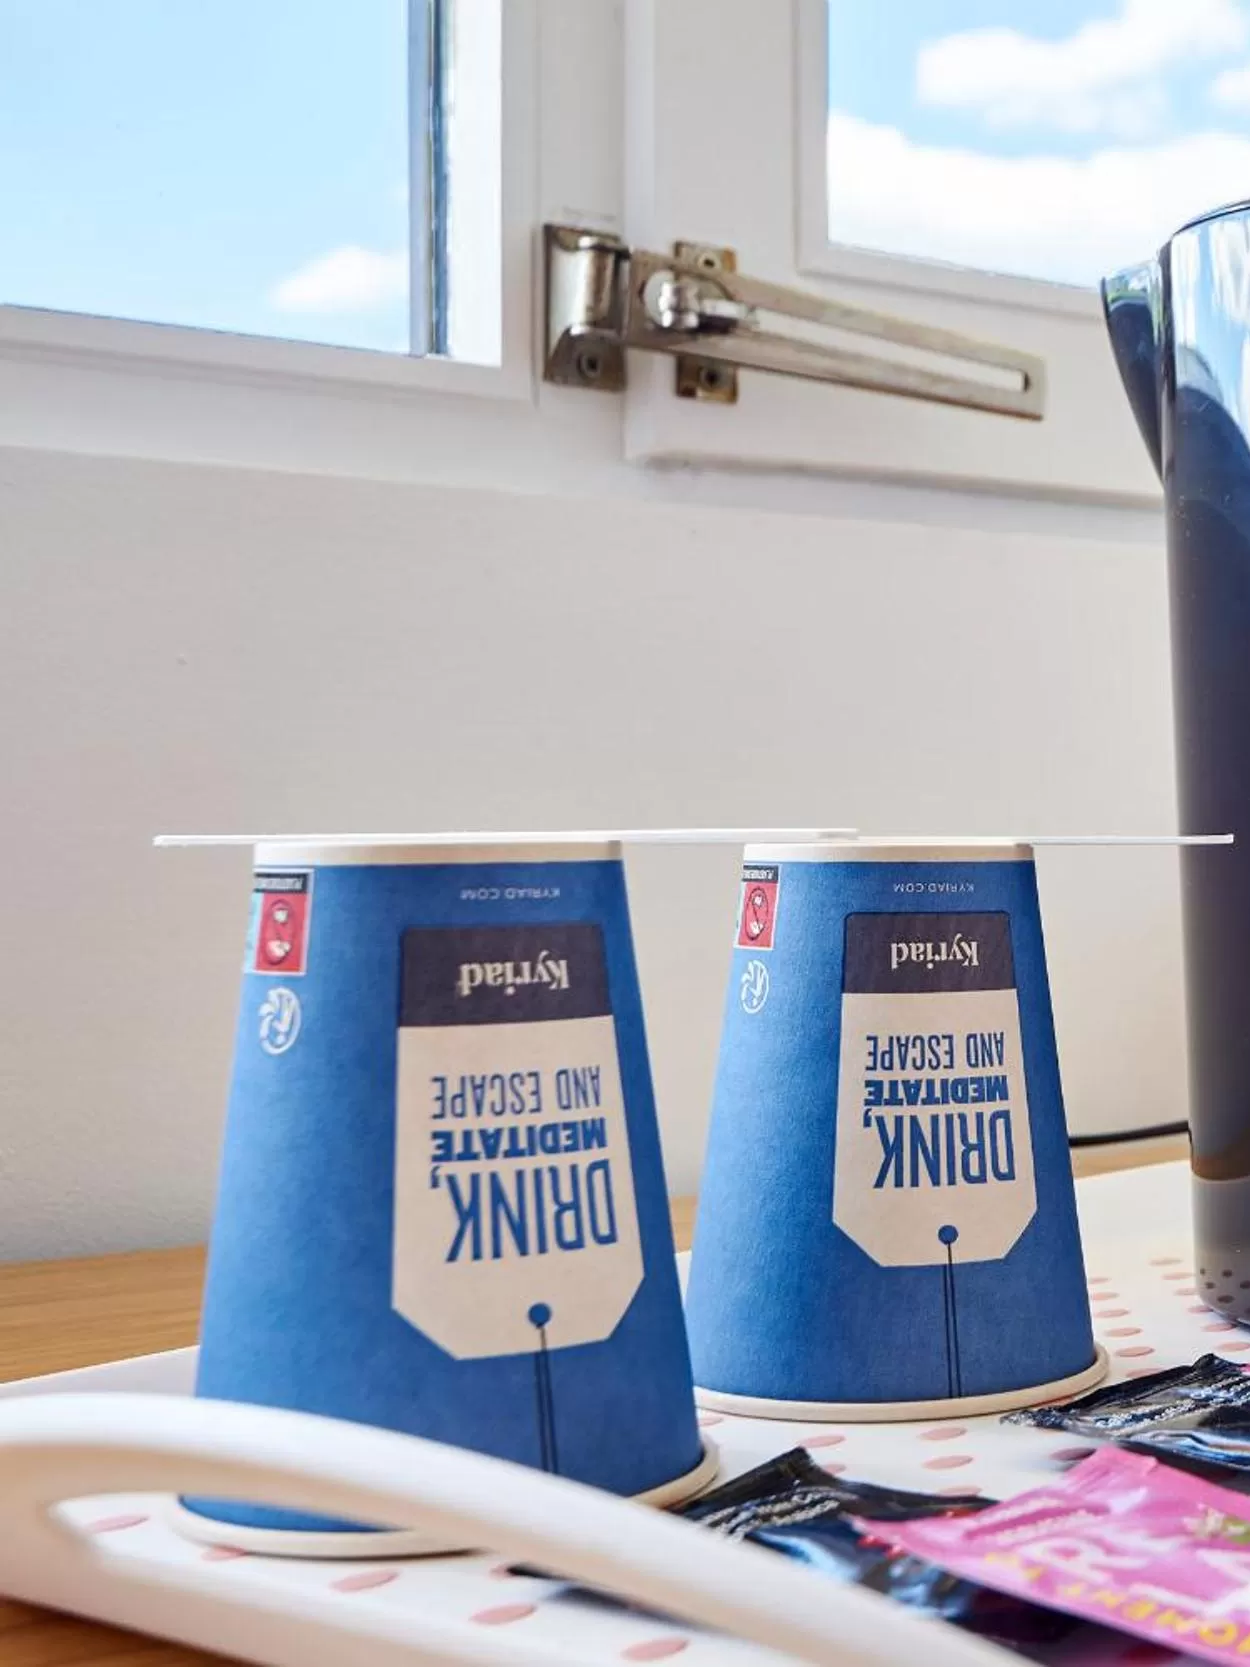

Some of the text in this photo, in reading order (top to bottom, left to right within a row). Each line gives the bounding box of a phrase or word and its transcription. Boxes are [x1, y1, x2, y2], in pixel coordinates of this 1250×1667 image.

[892, 881, 975, 894] KYRIAD.COM
[456, 949, 571, 997] Kyriad
[890, 932, 980, 970] Kyriad
[865, 1031, 1004, 1071] AND ESCAPE
[430, 1066, 600, 1119] AND ESCAPE
[863, 1075, 1009, 1107] MEDITATE
[430, 1117, 607, 1162] MEDITATE
[862, 1109, 1016, 1189] DRINK,
[429, 1158, 618, 1263] DRINK,
